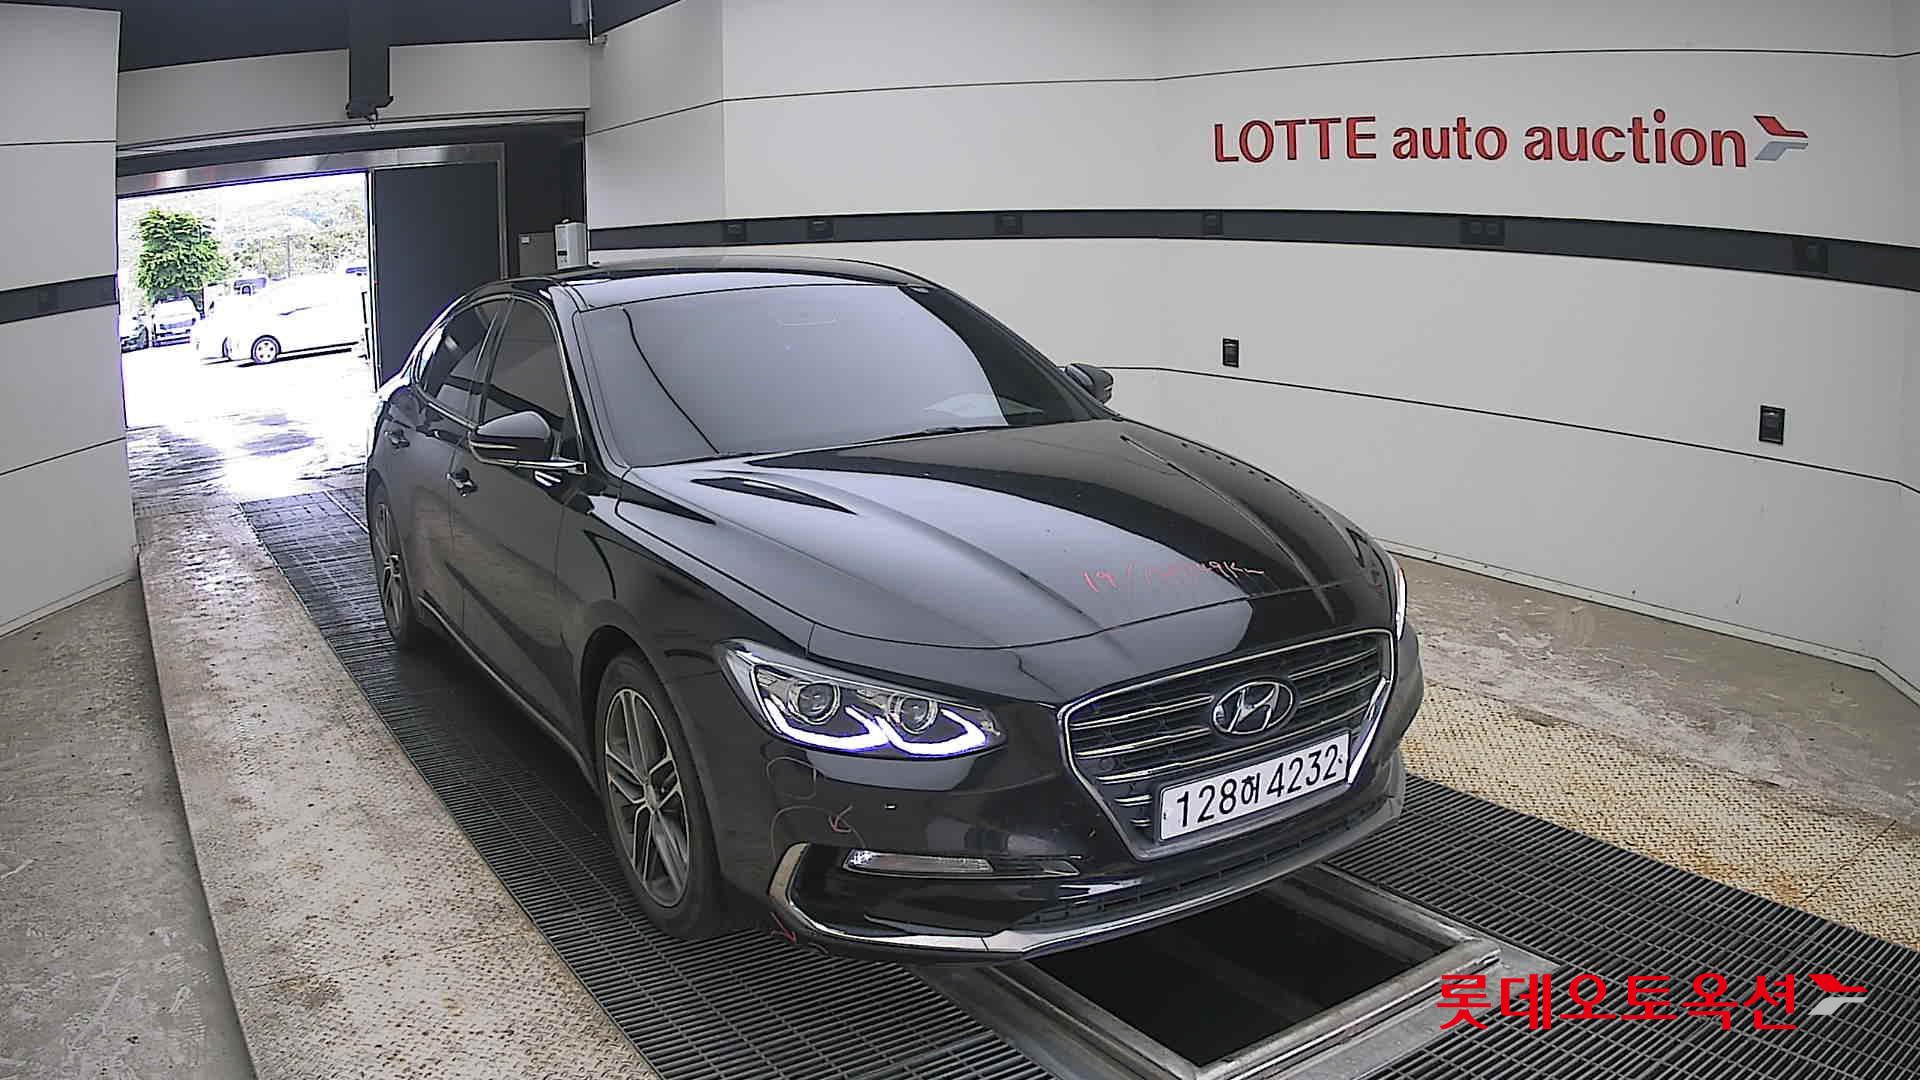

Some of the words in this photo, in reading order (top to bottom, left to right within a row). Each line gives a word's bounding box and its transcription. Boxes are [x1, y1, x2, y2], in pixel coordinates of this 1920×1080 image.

[1214, 116, 1377, 163] LOTTE
[1392, 116, 1509, 161] auto
[1523, 109, 1747, 168] auction
